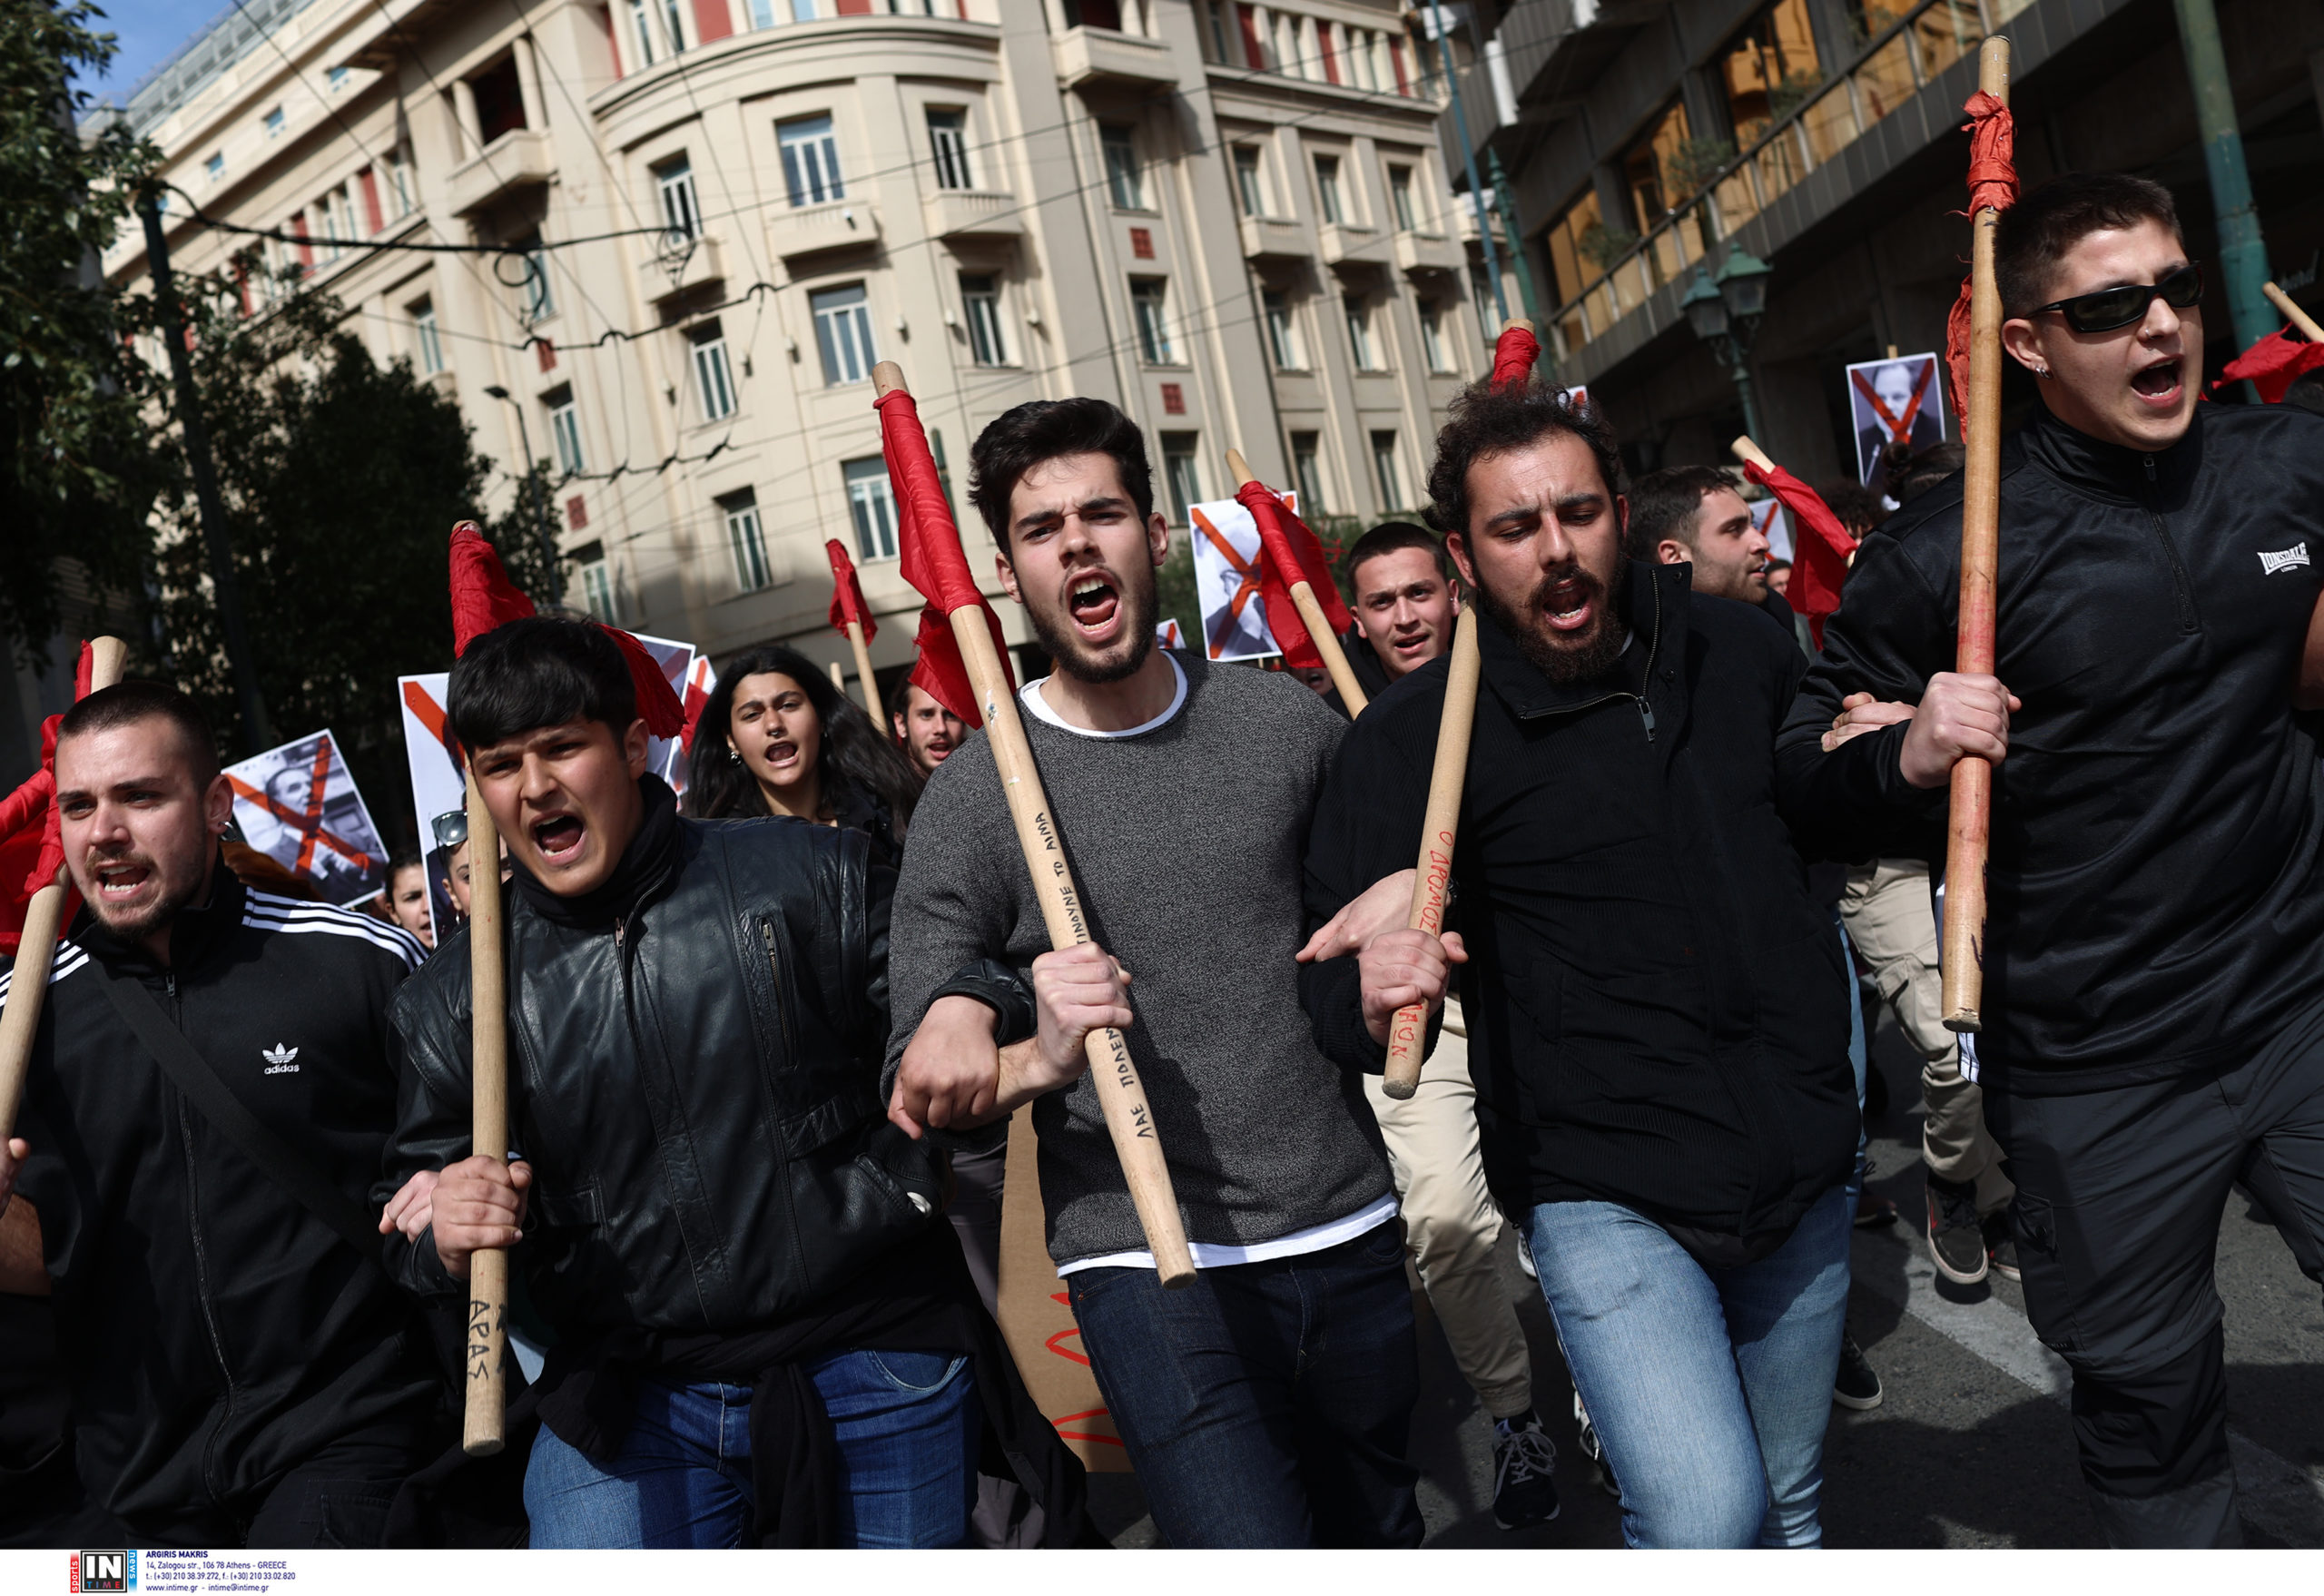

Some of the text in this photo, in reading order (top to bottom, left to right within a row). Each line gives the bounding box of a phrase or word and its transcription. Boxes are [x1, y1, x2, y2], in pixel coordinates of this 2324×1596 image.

[2257, 542, 2310, 576] LONSDALE
[1035, 812, 1058, 851] ΑΙΜΑ
[1419, 850, 1450, 936] ΔΡΟΜΟΣ
[264, 1063, 300, 1075] adidas
[1106, 1027, 1135, 1088] ΠΟΛΕΜ
